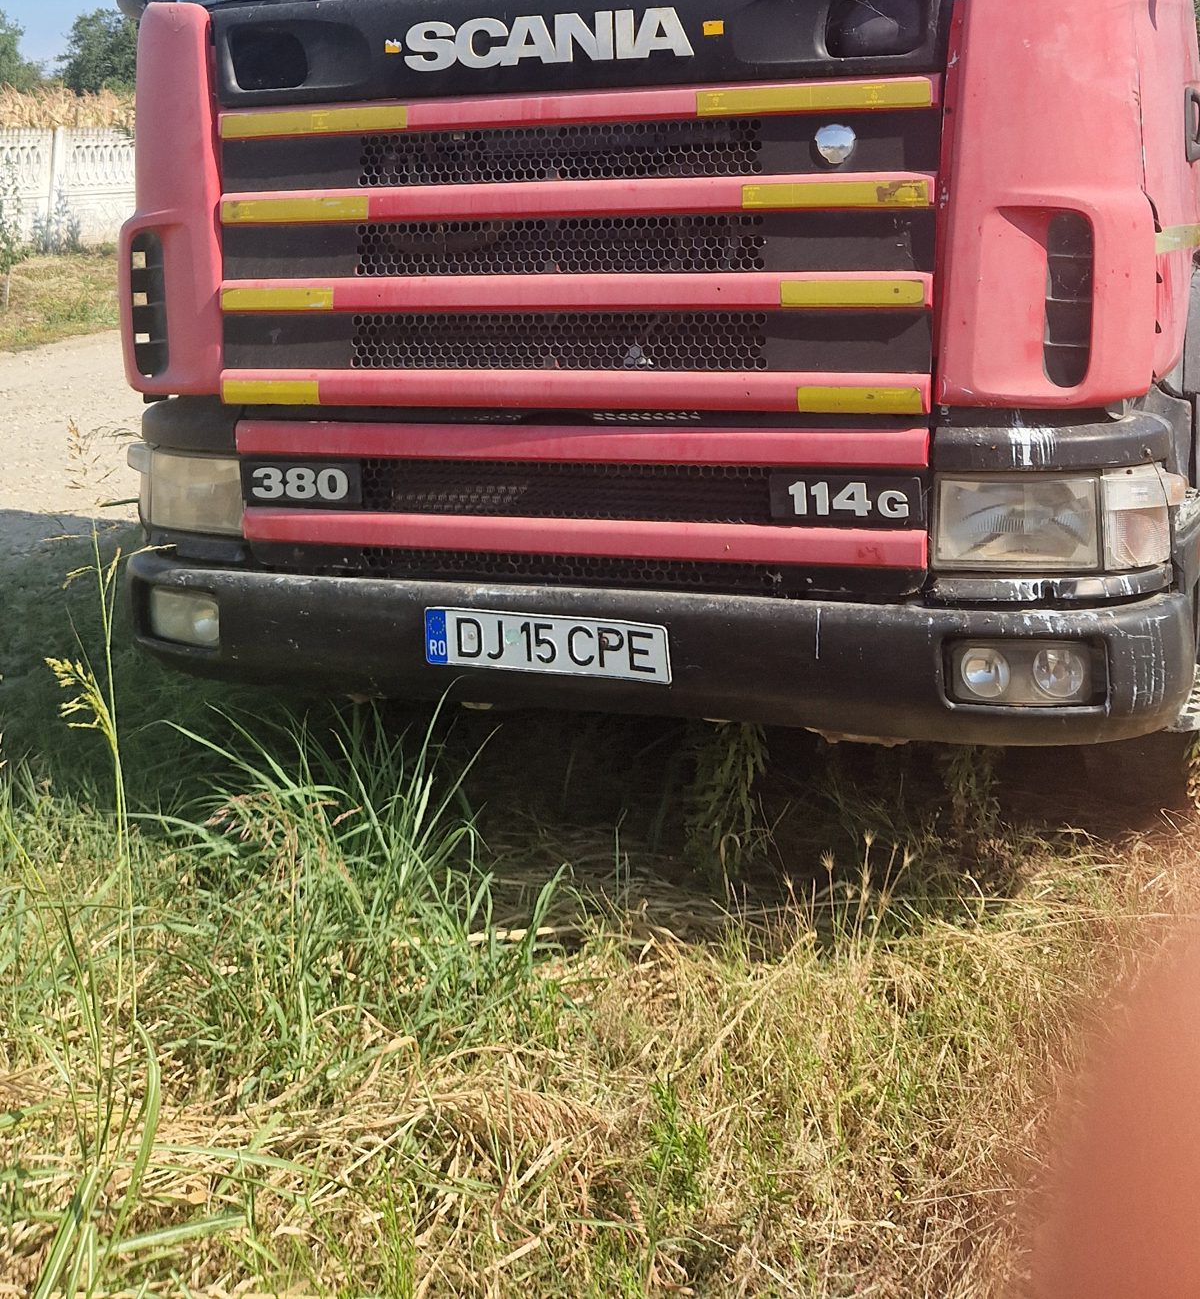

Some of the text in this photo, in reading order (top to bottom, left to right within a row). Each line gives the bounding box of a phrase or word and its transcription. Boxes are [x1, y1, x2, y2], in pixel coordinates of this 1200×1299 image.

[404, 6, 695, 72] SCANIA
[252, 467, 349, 500] 380
[430, 639, 446, 656] RO
[456, 617, 656, 674] DJ 15 CPE
